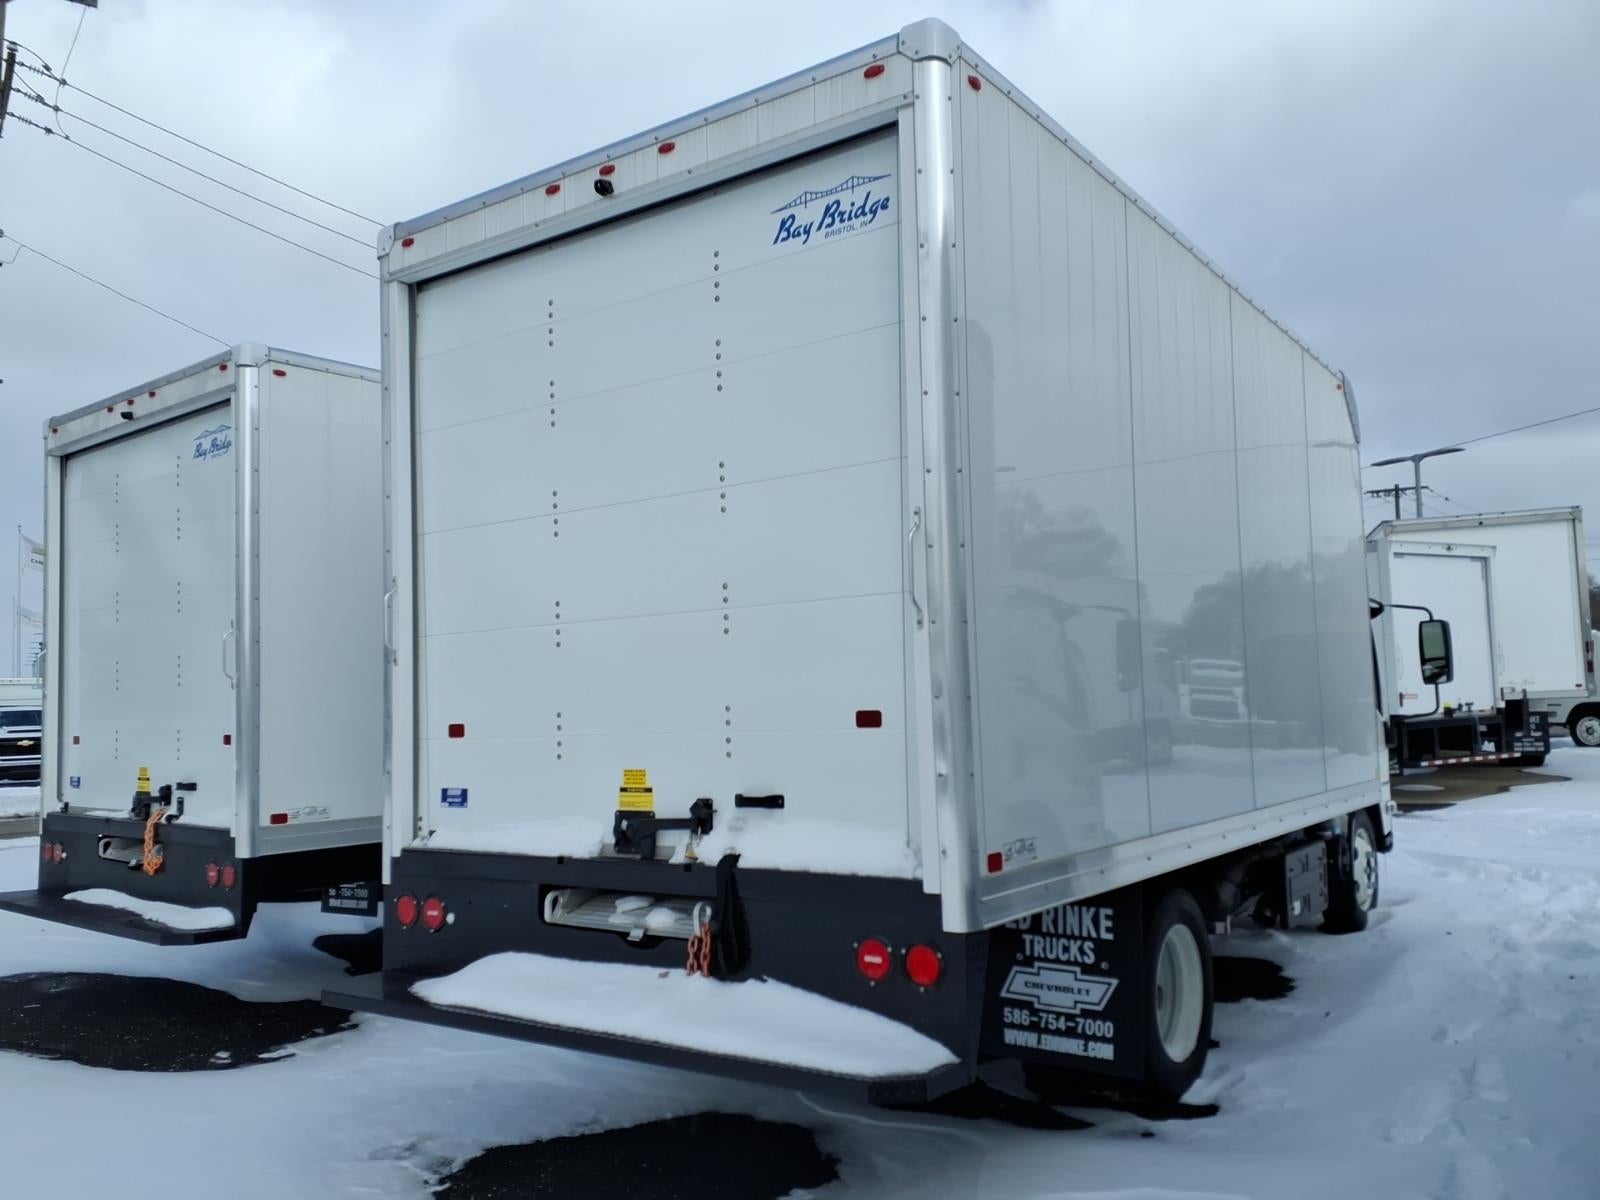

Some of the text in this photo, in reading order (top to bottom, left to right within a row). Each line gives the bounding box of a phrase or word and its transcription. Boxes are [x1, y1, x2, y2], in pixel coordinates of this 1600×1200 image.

[773, 190, 891, 245] Bay Bridge
[824, 219, 869, 239] BRISTOL, IN
[193, 443, 207, 460] Bay
[1041, 904, 1114, 940] RINKE
[1022, 934, 1096, 964] TRUCKS
[1024, 980, 1091, 996] CHEVROLET
[1003, 1007, 1114, 1038] 586-754-7000
